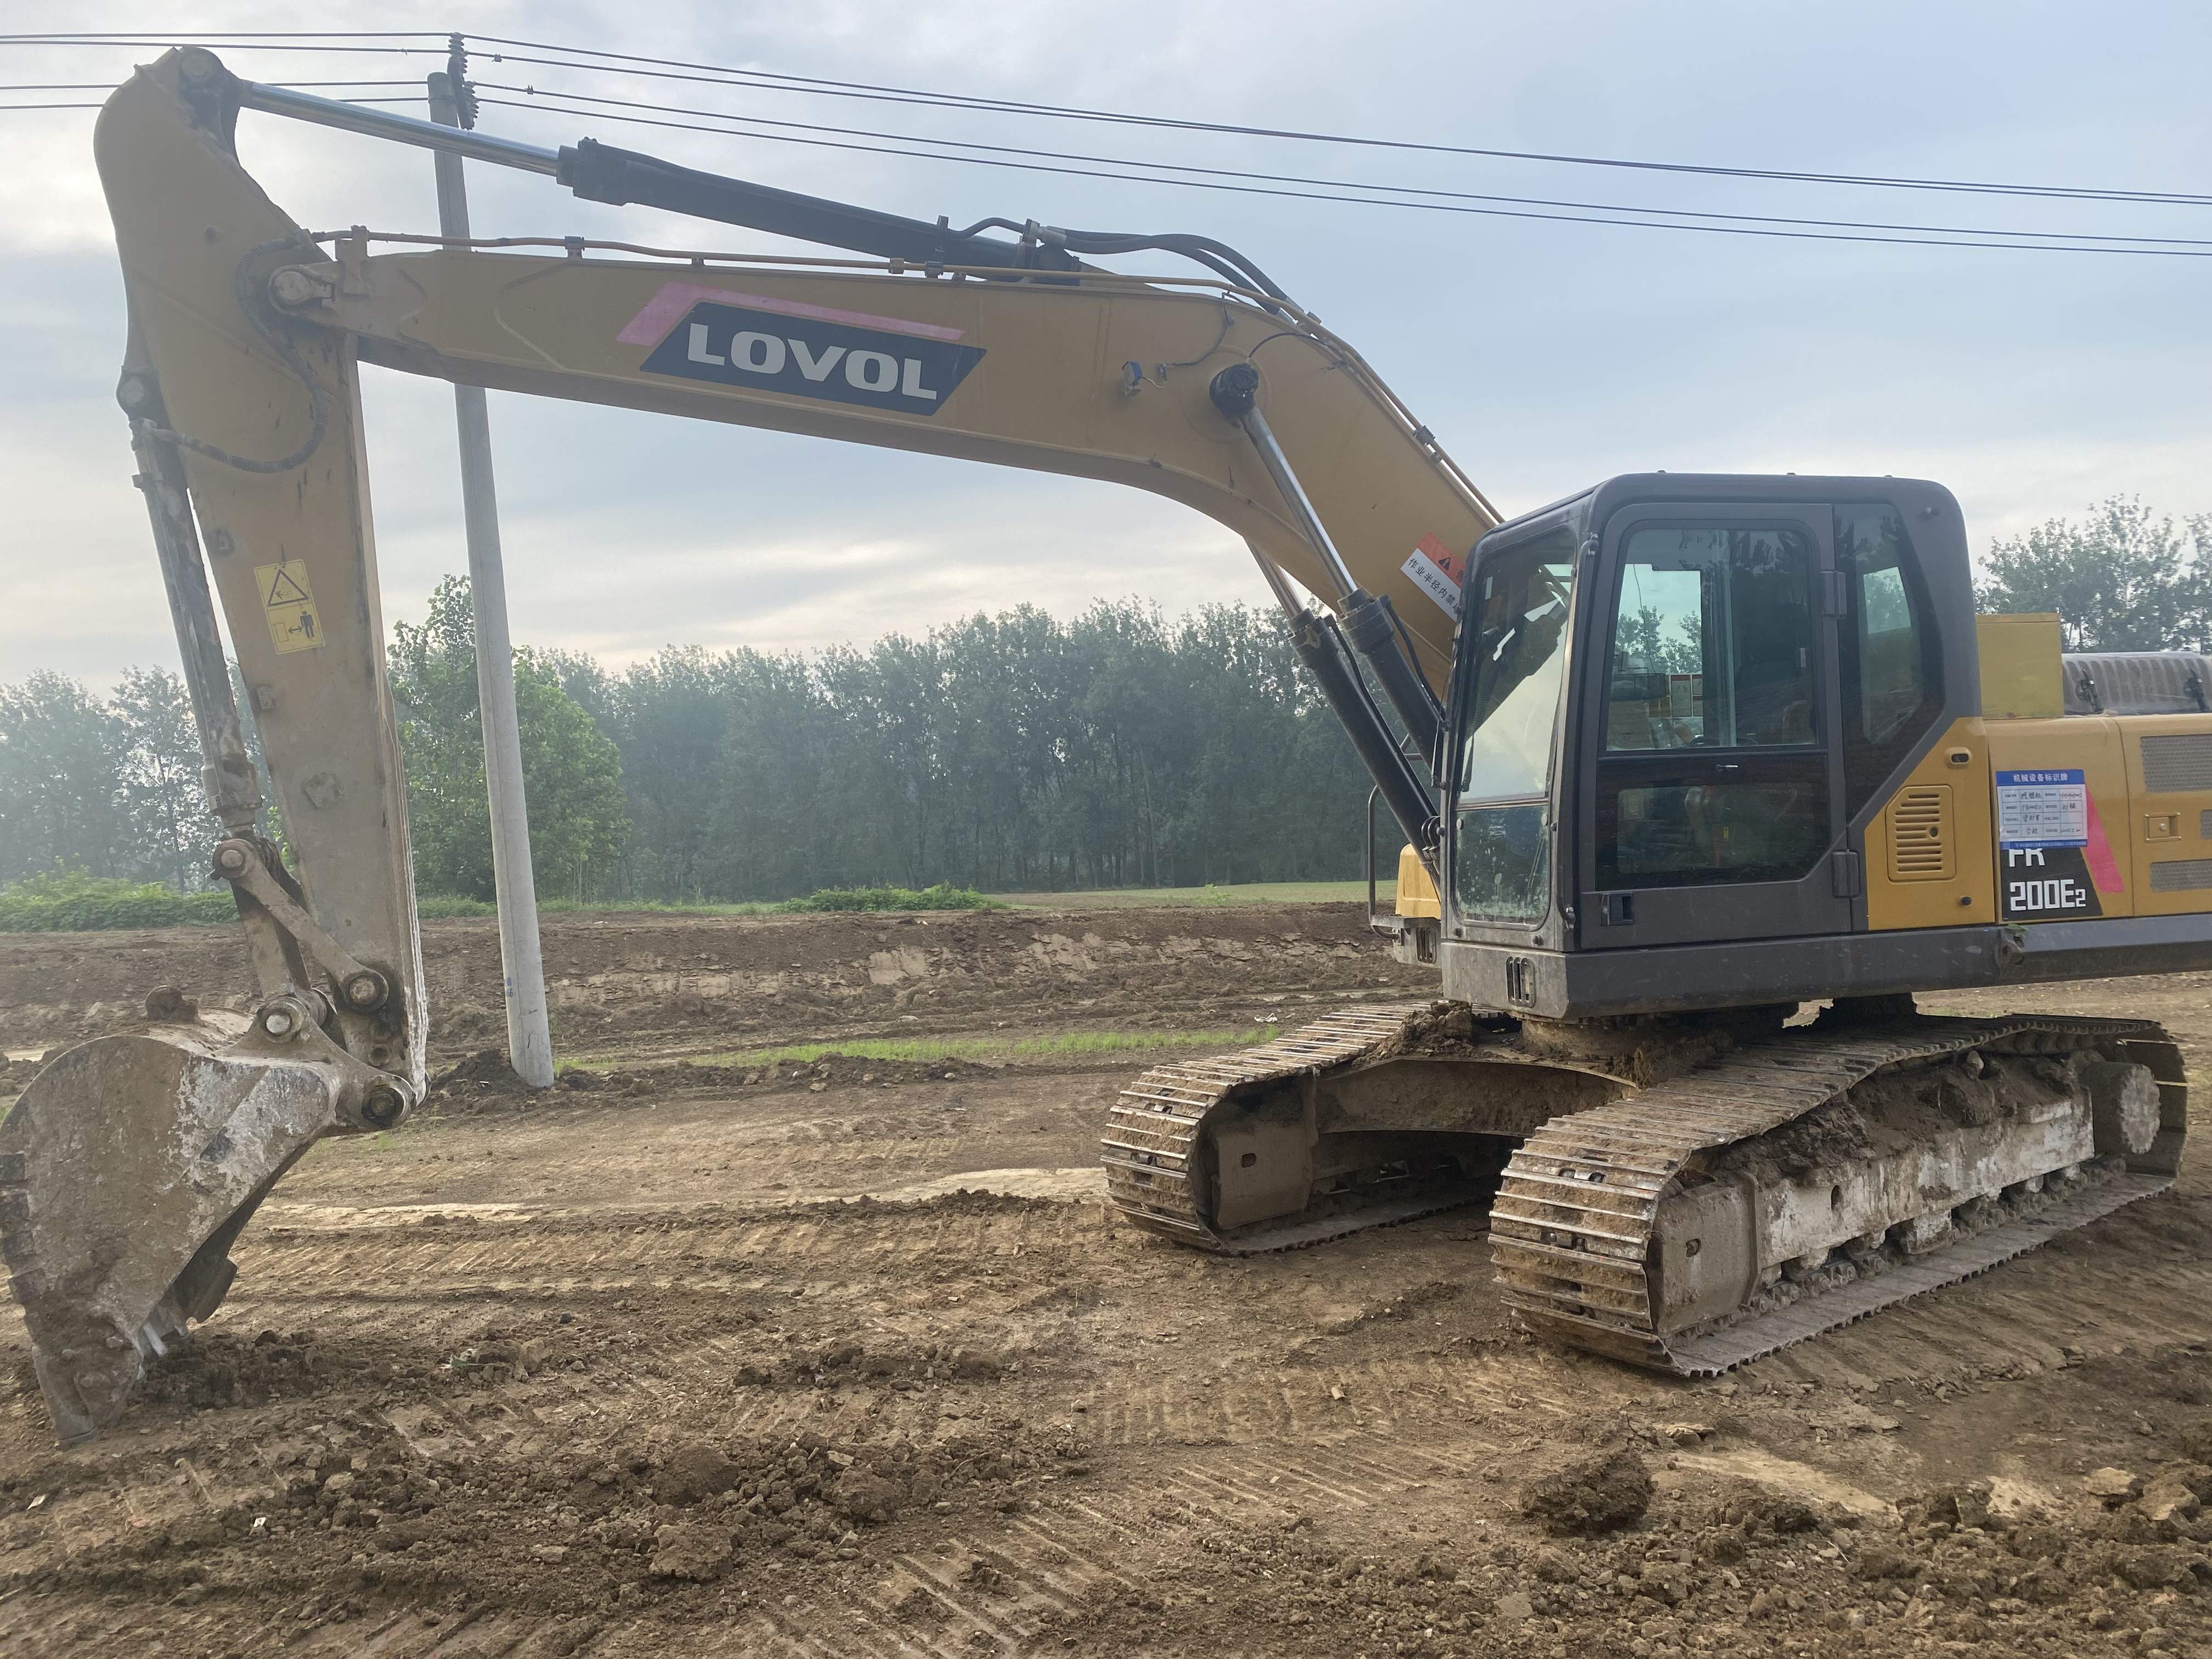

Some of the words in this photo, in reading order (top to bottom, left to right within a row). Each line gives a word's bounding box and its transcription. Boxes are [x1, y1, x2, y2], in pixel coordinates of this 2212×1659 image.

[687, 323, 937, 400] LOVOL
[2013, 773, 2068, 782] 机械设备标识牌
[2010, 879, 2086, 911] 200E2
